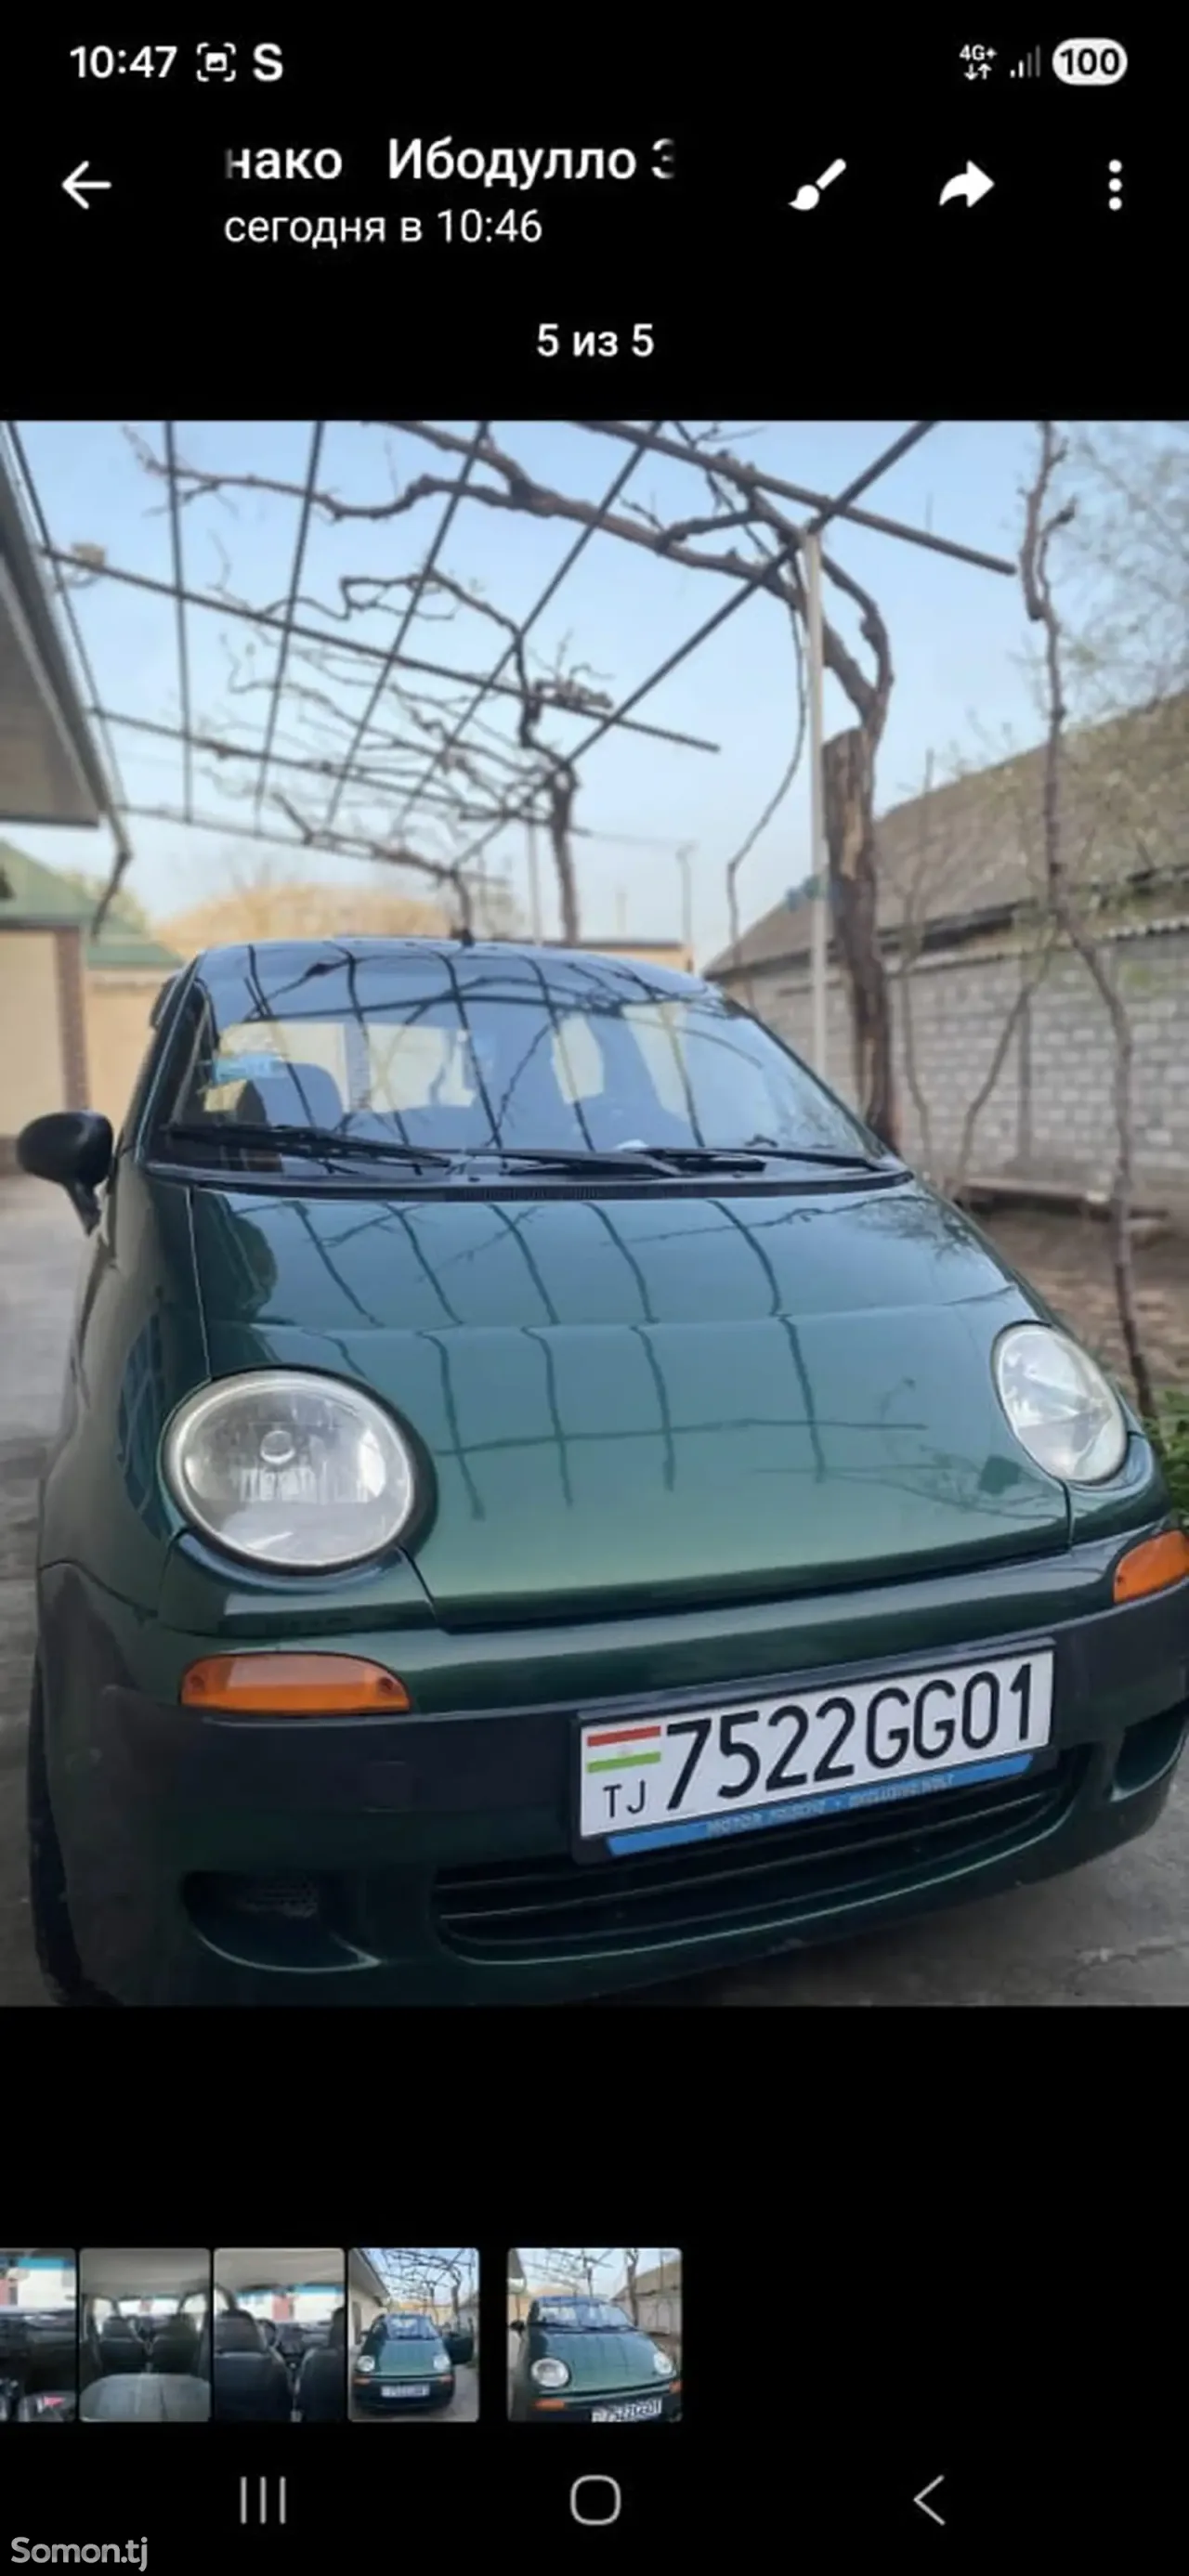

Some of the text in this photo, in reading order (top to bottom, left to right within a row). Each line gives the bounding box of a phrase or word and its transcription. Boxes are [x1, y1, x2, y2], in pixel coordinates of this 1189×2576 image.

[70, 46, 177, 79] 10:47
[960, 45, 998, 61] 4G+
[1061, 47, 1120, 76] 100
[388, 136, 637, 191] Ибодулло
[225, 209, 542, 250] сегодня в 10:46
[537, 323, 654, 358] 5 из 5
[665, 1663, 1032, 1811] 7522GG01
[603, 1780, 647, 1819] TJ
